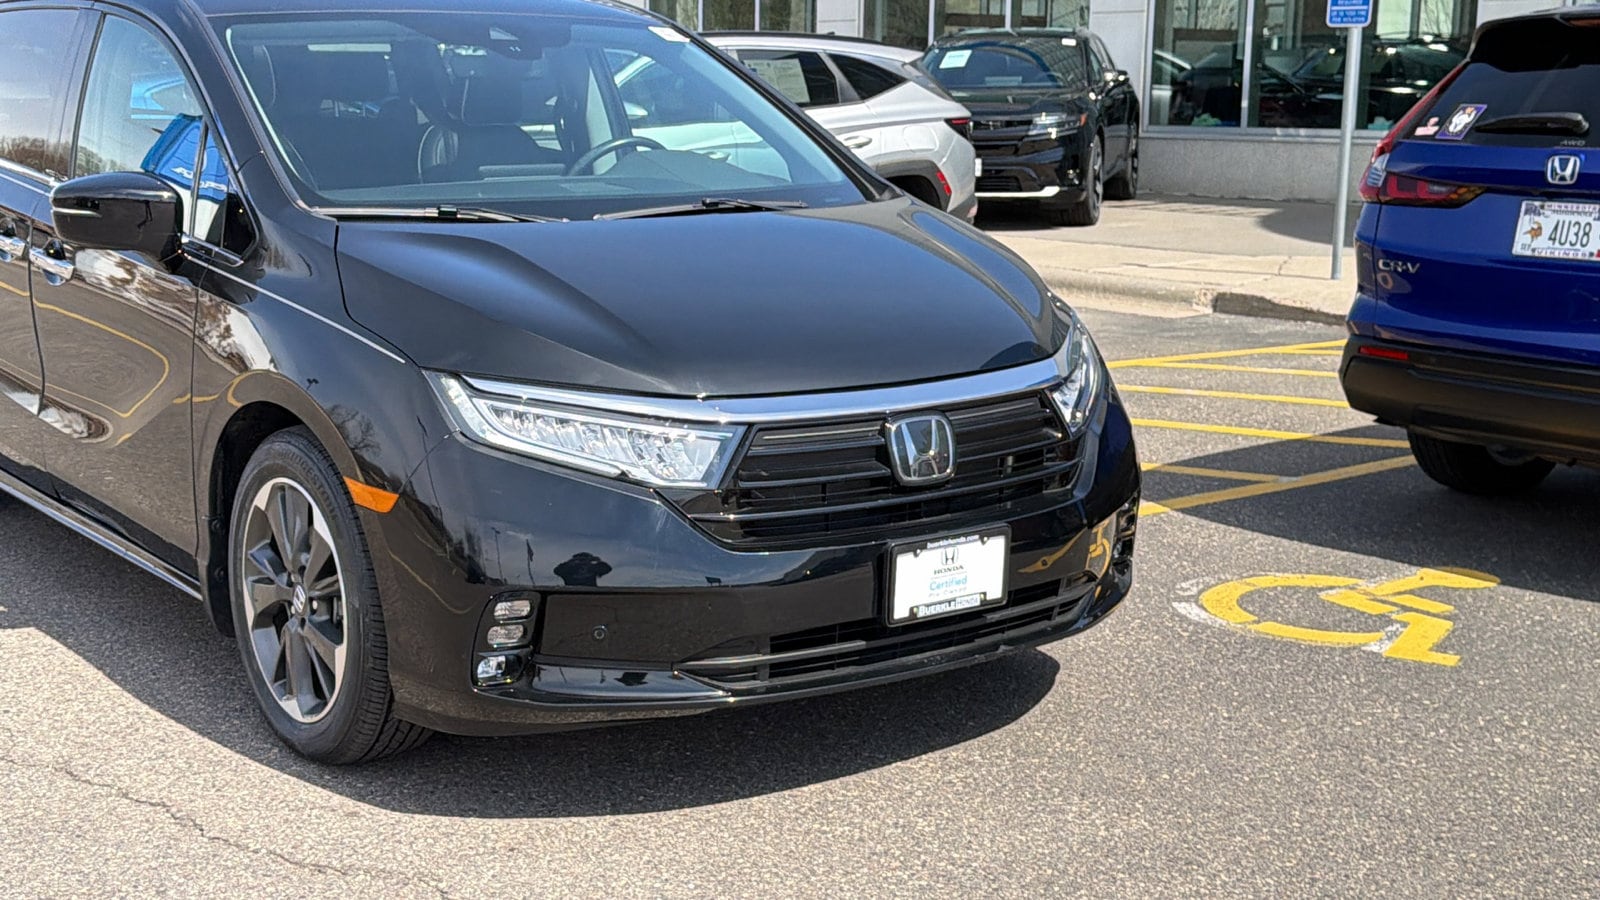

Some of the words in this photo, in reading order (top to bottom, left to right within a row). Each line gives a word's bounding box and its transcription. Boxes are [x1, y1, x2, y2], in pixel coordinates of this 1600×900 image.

[1560, 139, 1585, 147] AWD
[1548, 219, 1593, 248] 4U38
[1536, 249, 1588, 258] VIKINGS
[1378, 258, 1421, 274] CR-V
[933, 564, 964, 575] HONDA
[929, 575, 967, 591] Certified
